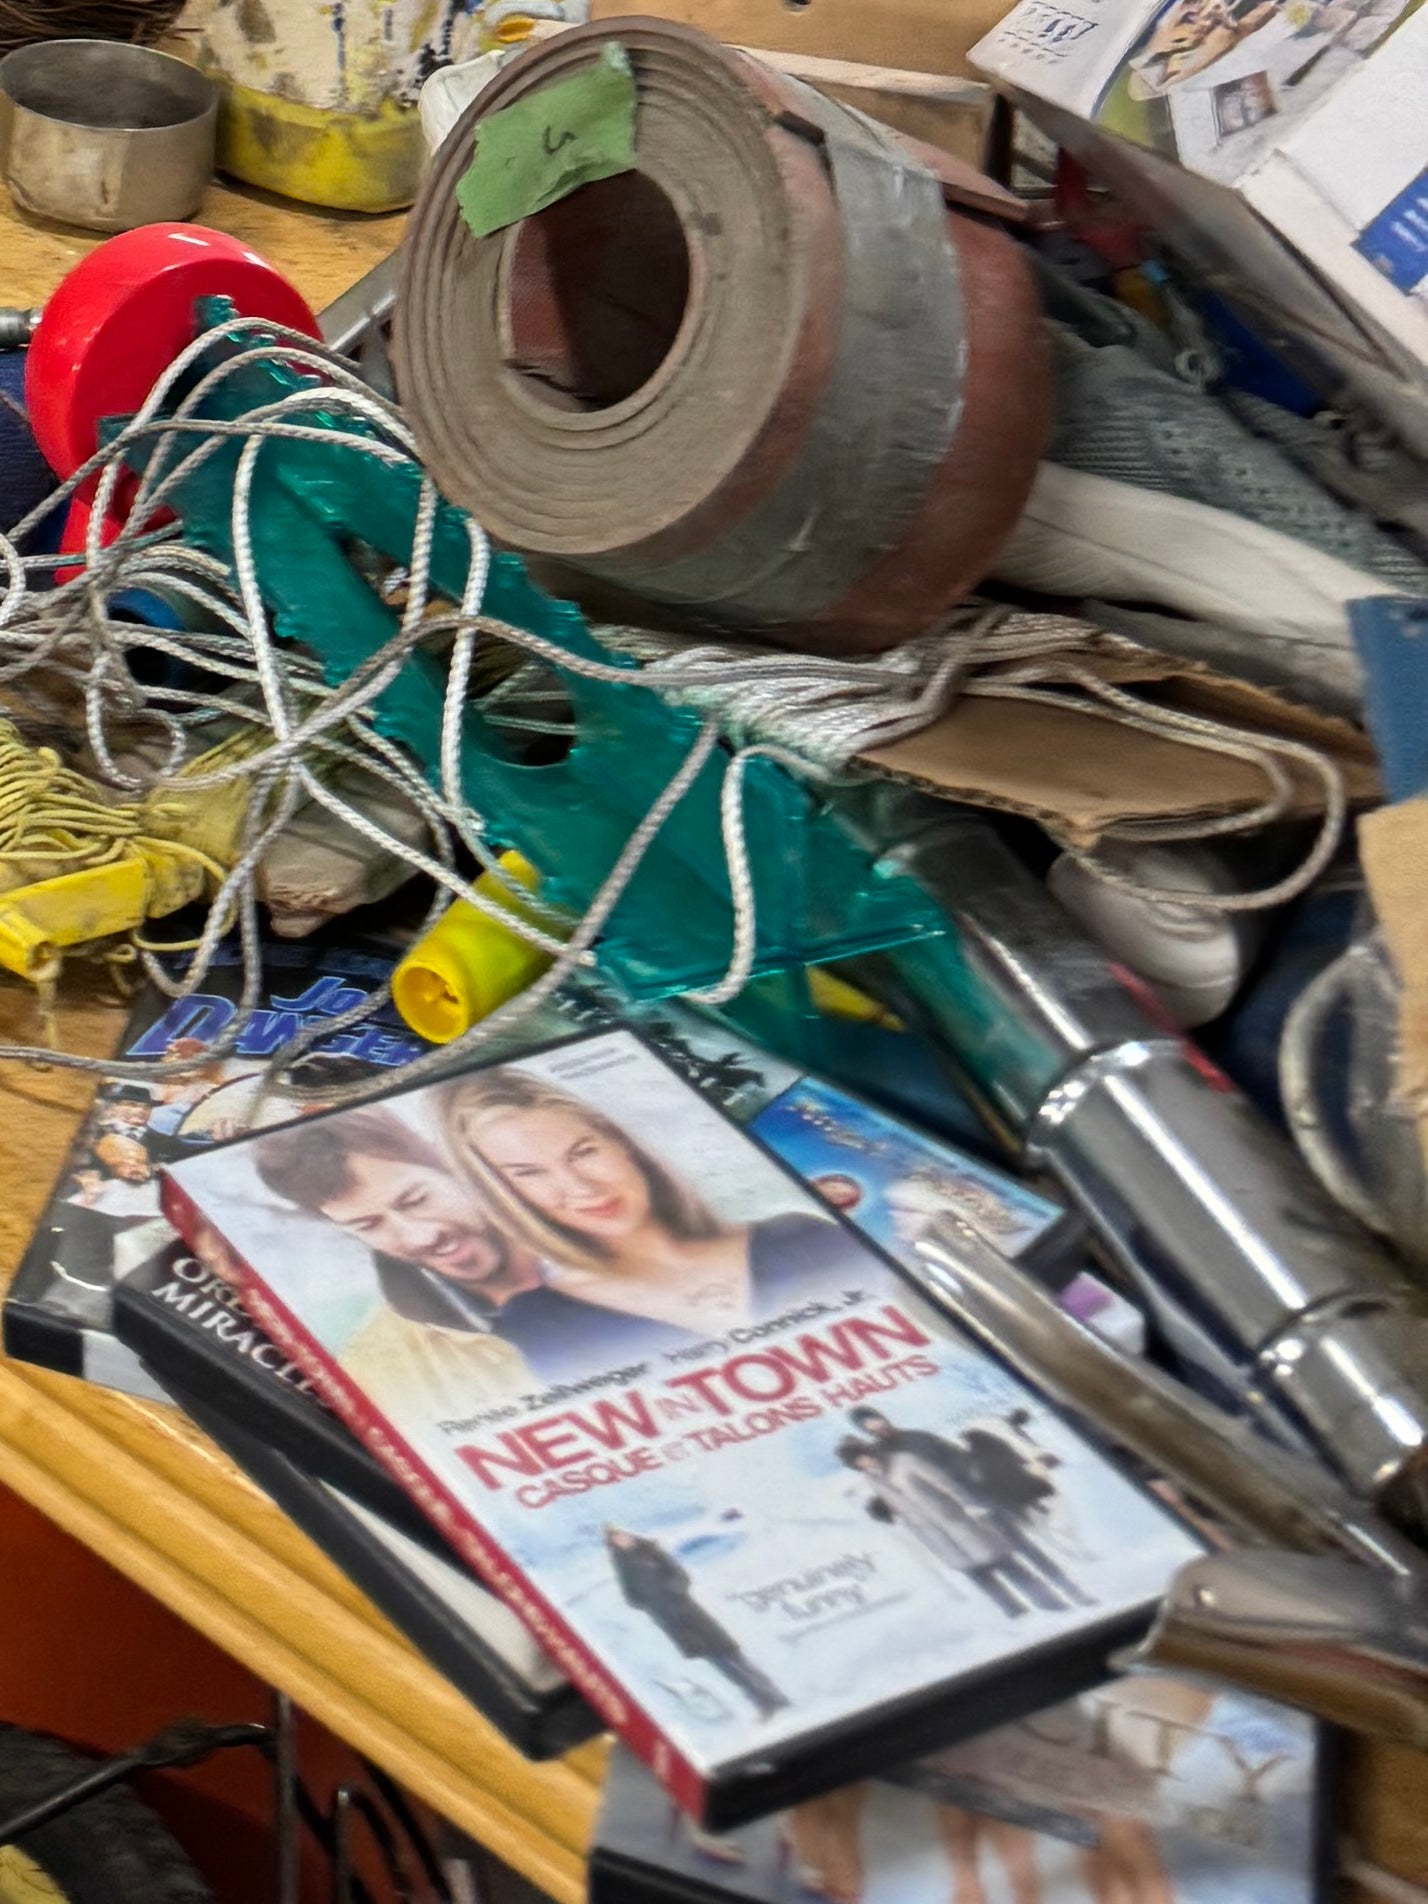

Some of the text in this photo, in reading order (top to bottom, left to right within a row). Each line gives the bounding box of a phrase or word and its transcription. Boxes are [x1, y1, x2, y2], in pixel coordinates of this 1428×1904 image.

[655, 1392, 703, 1423] IN
[663, 1304, 932, 1417] TOWN
[454, 1389, 659, 1491] NEW
[515, 1446, 664, 1510] CASQUE
[682, 1395, 823, 1453] TALONS
[825, 1352, 942, 1409] HAUTS
